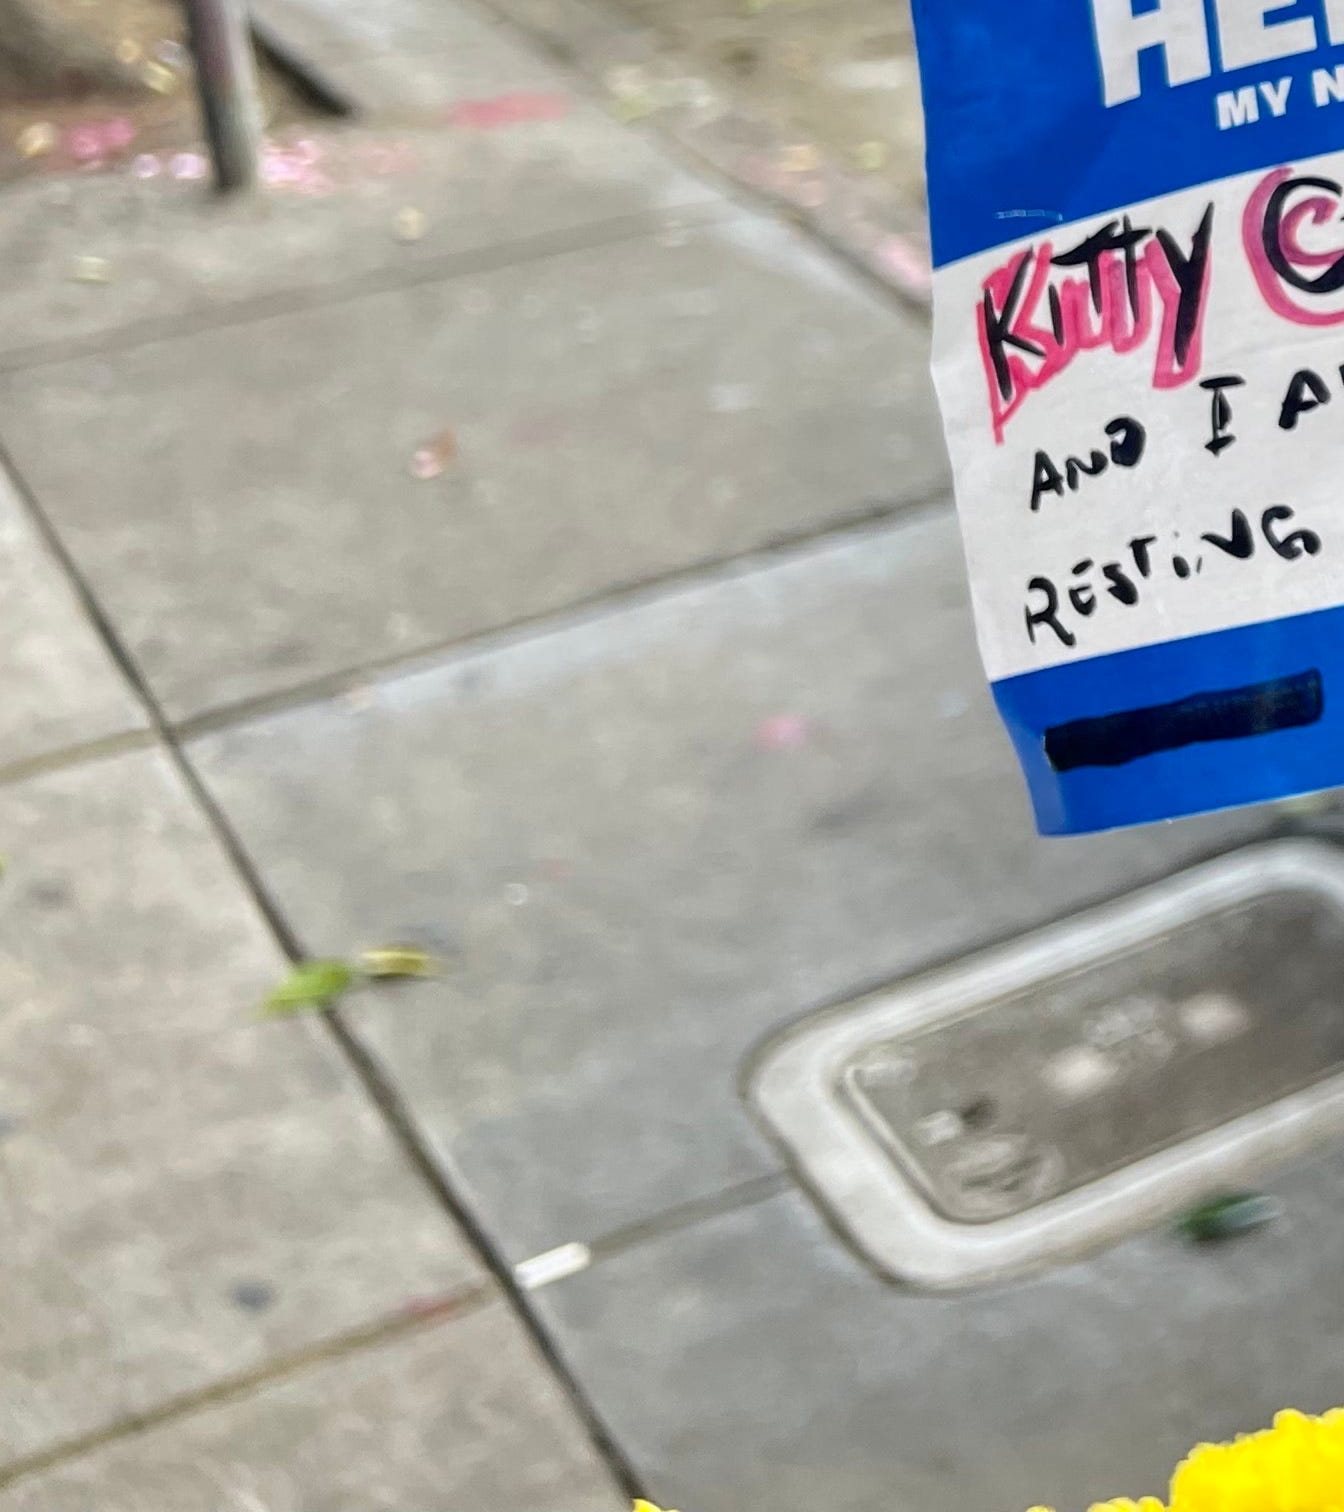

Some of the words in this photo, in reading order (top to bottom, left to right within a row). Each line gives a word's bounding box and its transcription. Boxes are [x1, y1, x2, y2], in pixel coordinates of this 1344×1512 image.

[1216, 74, 1292, 131] MY
[1029, 416, 1147, 512] AND
[1199, 375, 1246, 456] I
